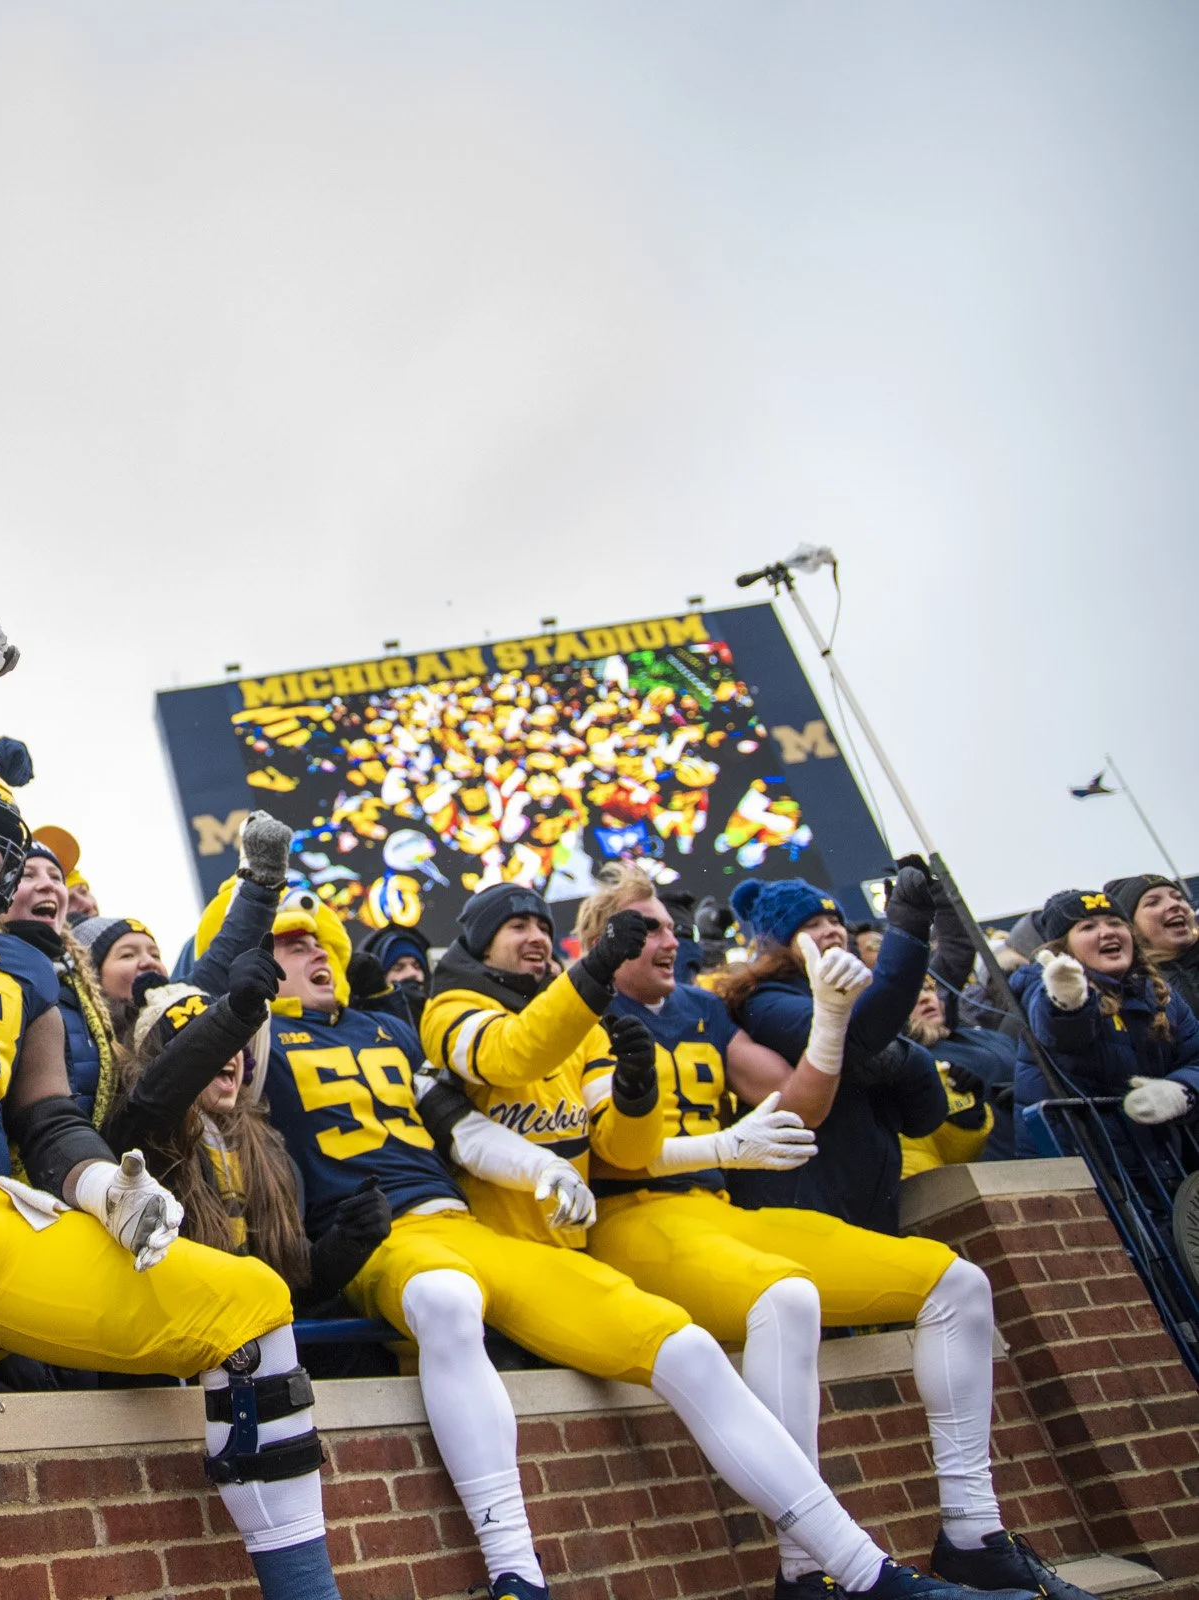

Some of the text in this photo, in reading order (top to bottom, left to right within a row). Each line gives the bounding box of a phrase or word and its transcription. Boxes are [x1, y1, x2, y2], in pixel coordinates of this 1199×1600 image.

[238, 613, 710, 709] MICHIGAN STADIUM
[771, 720, 837, 764] M
[192, 809, 250, 855] M
[1080, 893, 1111, 911] M
[165, 995, 209, 1031] M
[285, 1045, 436, 1161] 59
